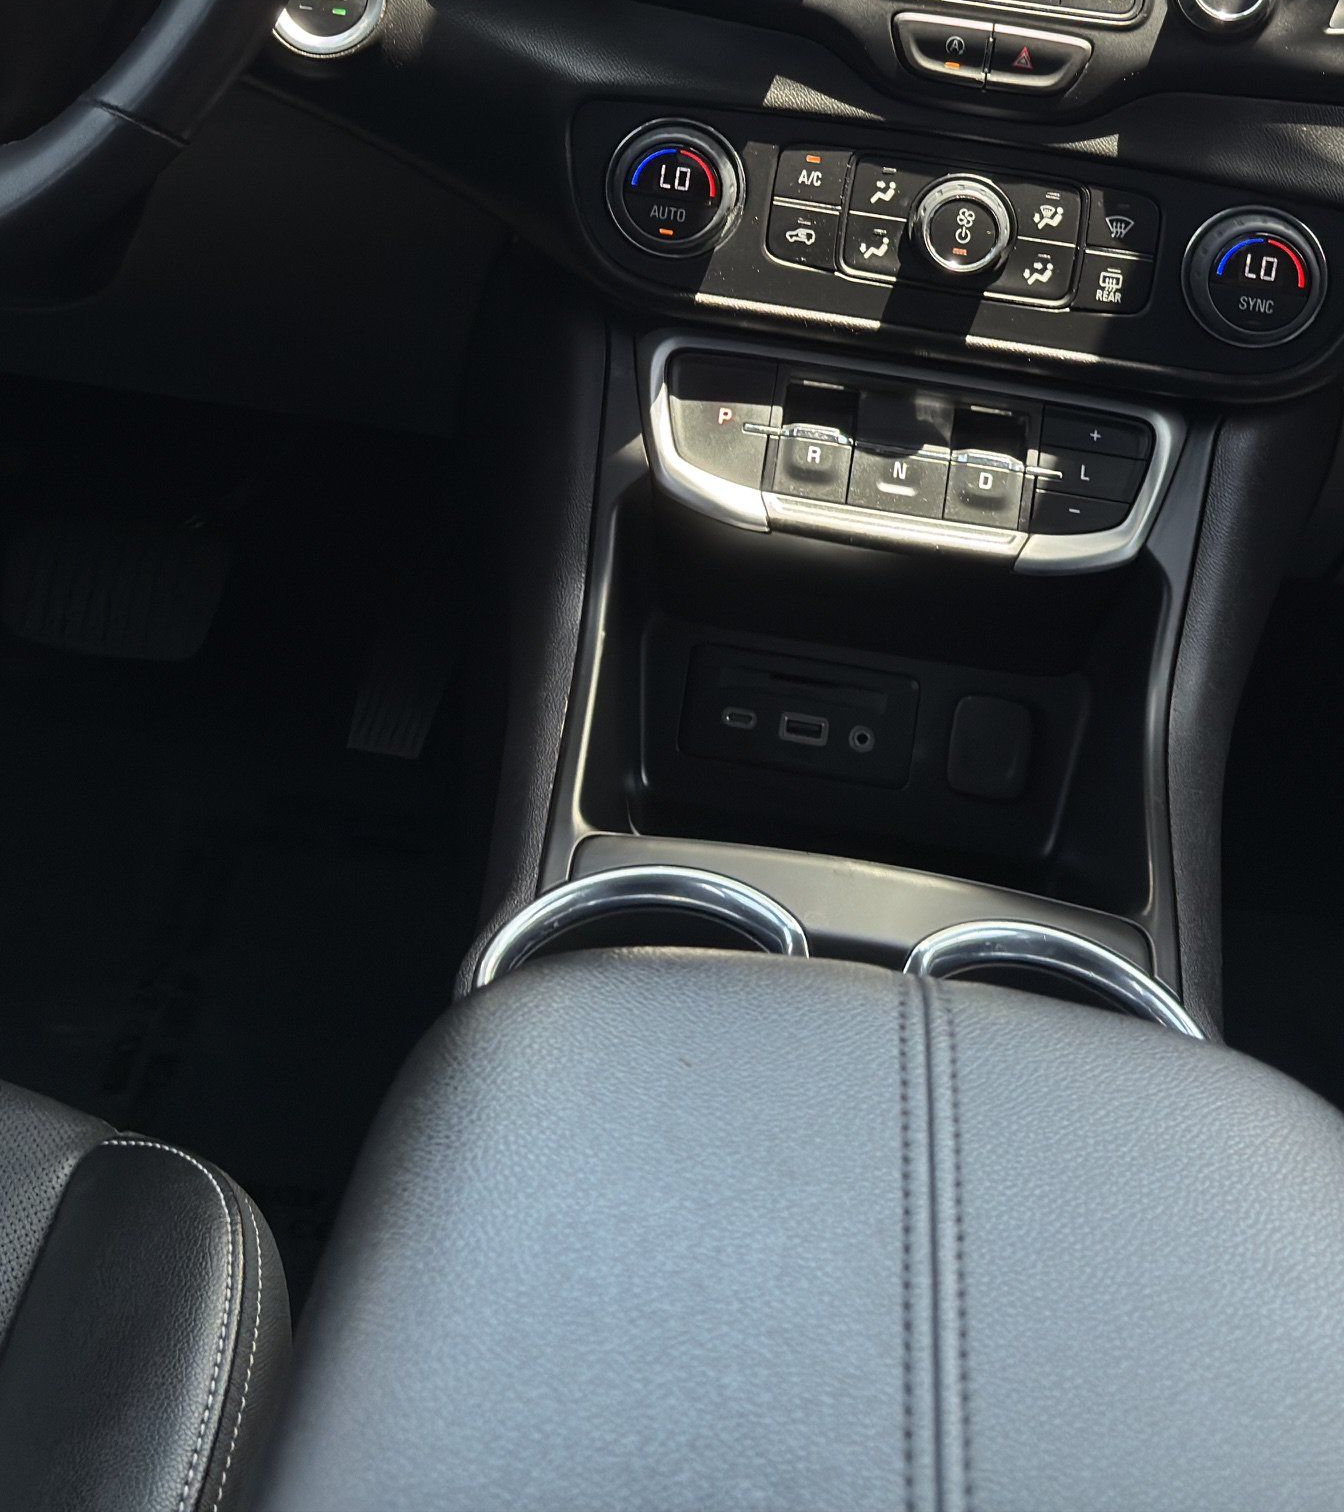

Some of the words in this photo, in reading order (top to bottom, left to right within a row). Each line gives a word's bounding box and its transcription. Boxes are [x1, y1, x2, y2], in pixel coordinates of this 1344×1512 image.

[659, 164, 692, 192] LO
[798, 169, 823, 187] A/C
[649, 204, 686, 223] AUTO
[1244, 252, 1278, 283] LO
[1095, 289, 1122, 304] REAR
[1238, 295, 1275, 315] SYNC
[718, 407, 733, 426] P
[808, 446, 821, 465] R
[893, 462, 907, 480] N
[1080, 464, 1090, 482] L
[979, 472, 993, 491] D
